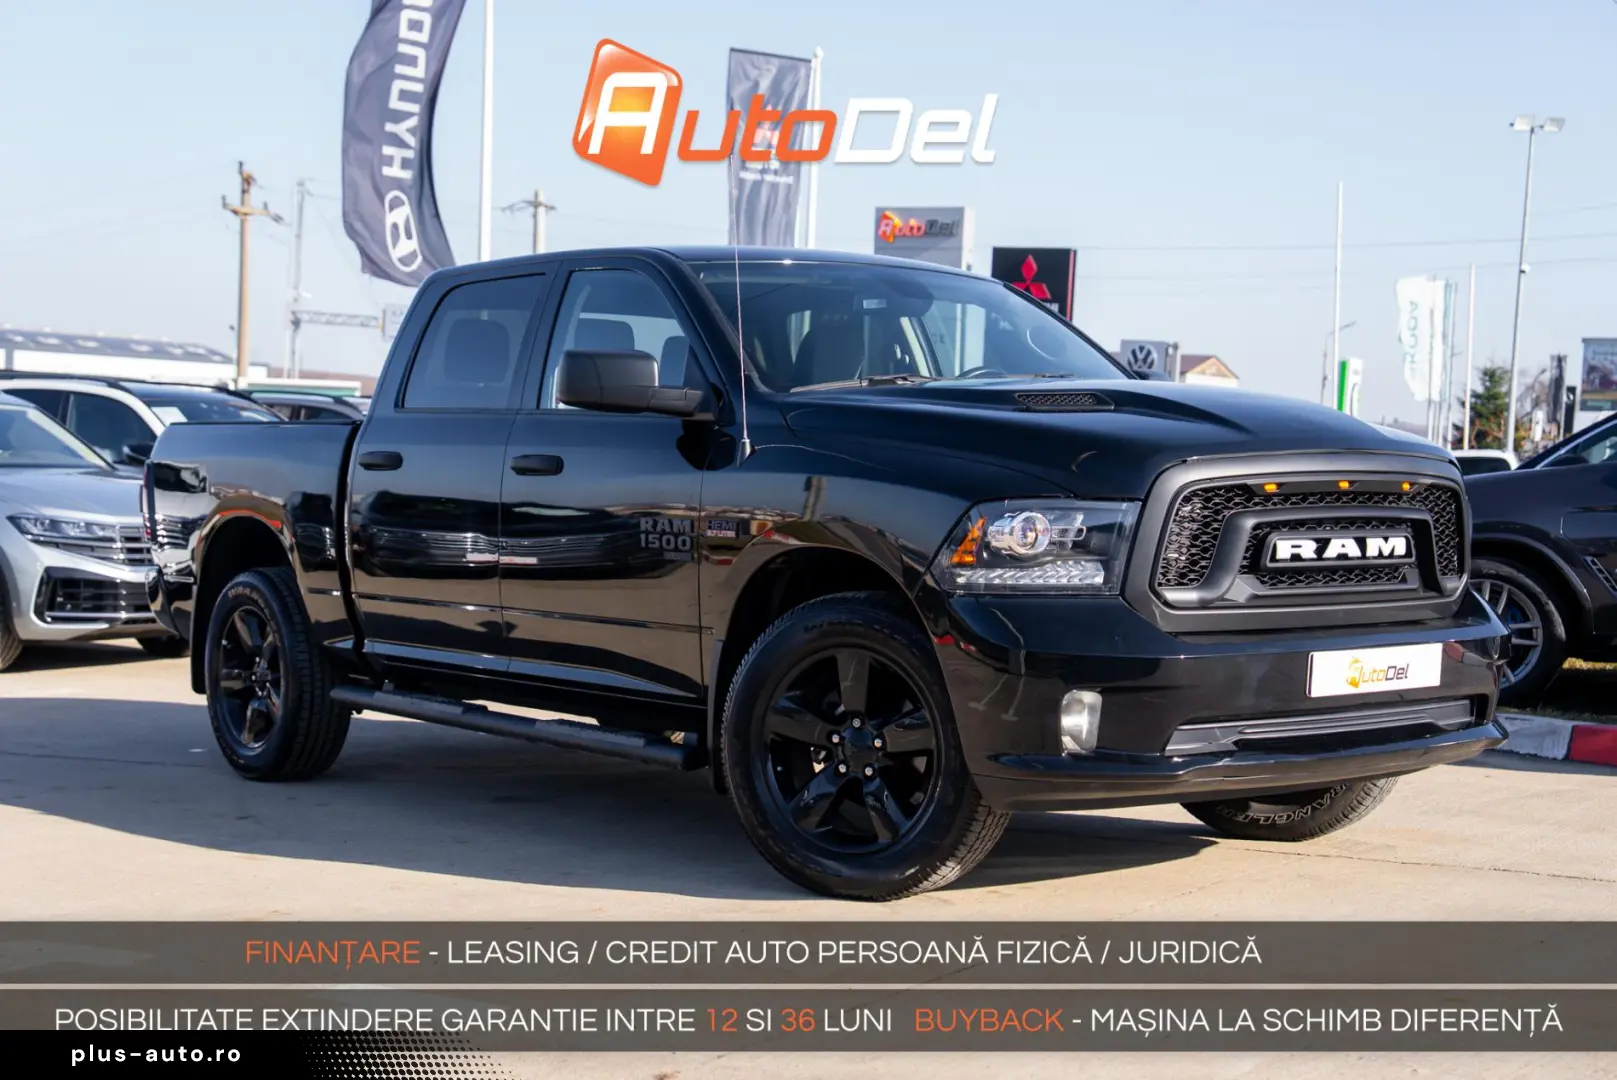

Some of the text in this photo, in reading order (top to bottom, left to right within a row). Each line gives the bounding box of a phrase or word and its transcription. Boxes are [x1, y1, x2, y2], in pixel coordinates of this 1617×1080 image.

[640, 517, 692, 533] RAM
[707, 519, 737, 531] HEMI
[640, 533, 692, 550] 1500
[1275, 536, 1407, 559] RAM
[1349, 661, 1409, 686] AutoDel
[1216, 783, 1350, 824] RANGLER
